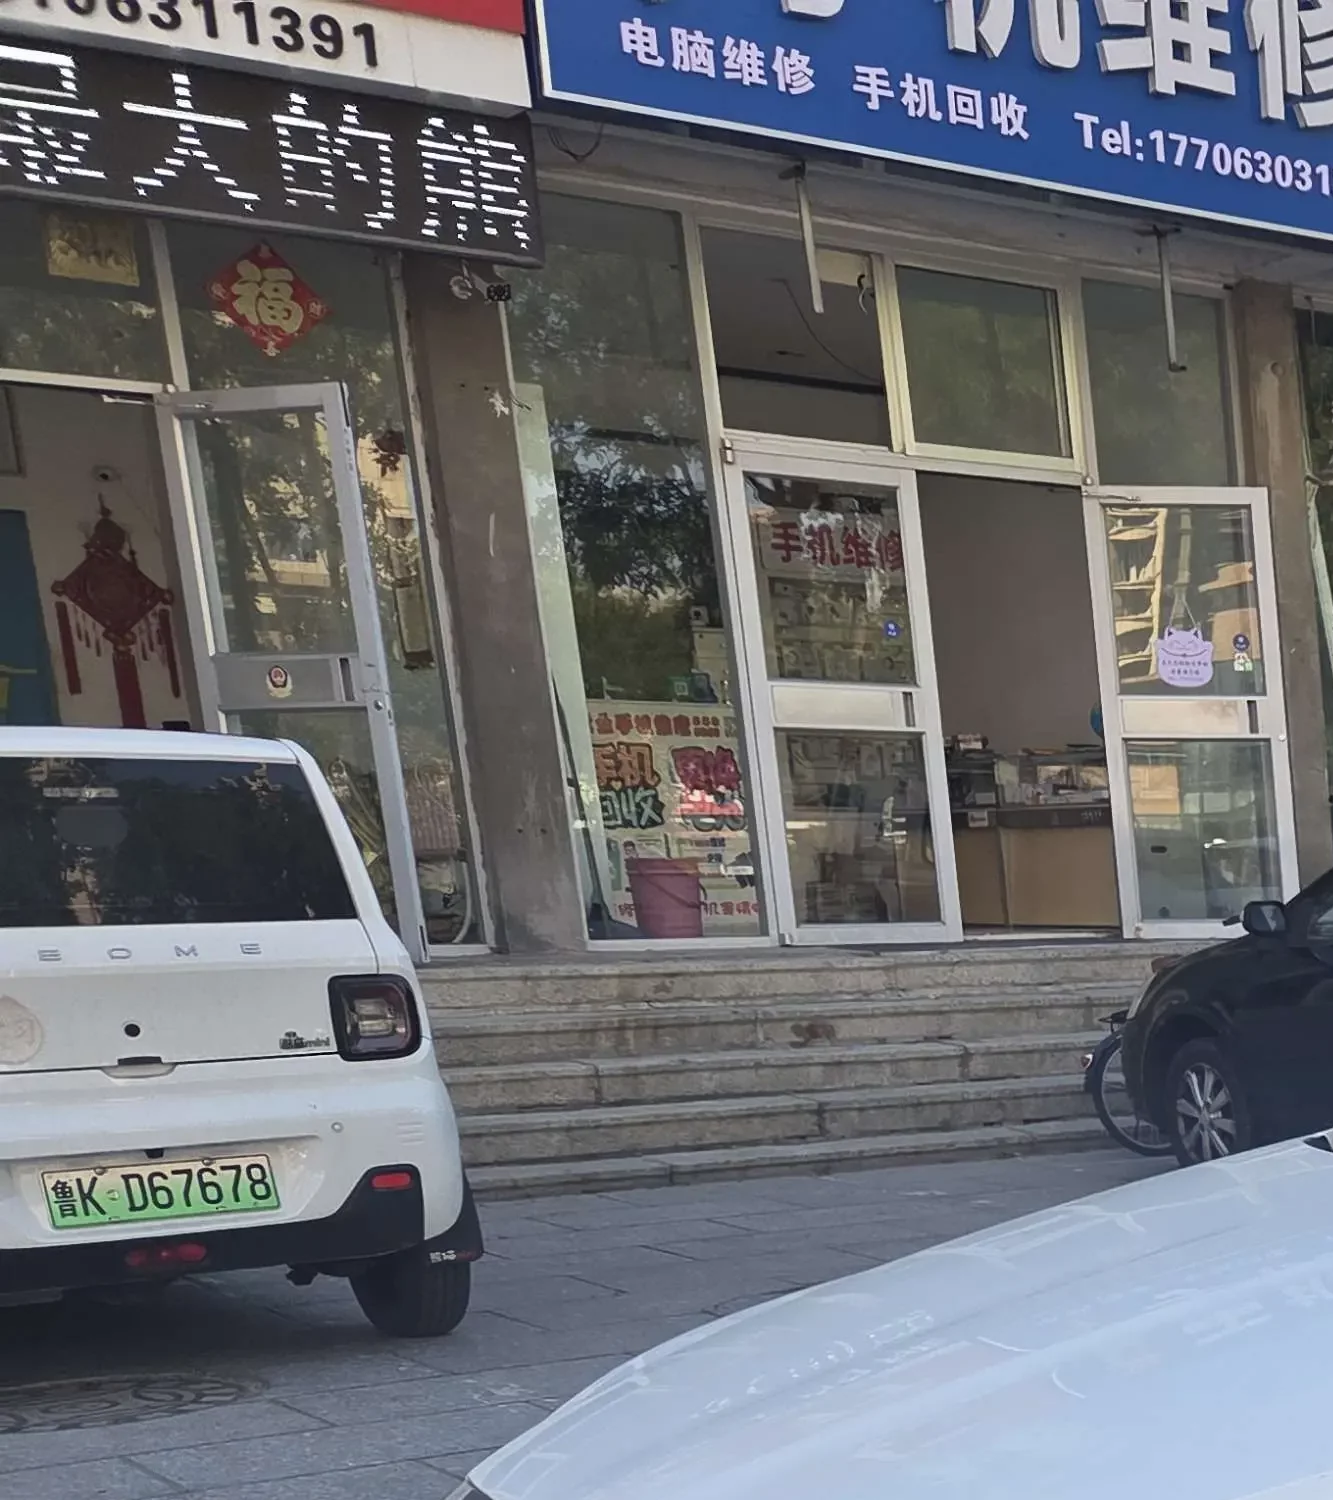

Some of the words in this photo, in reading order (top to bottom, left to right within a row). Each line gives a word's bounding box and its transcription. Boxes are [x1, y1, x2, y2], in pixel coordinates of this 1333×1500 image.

[619, 17, 816, 95] 电脑维修
[852, 64, 1030, 142] 手机回收
[231, 259, 304, 334] 福
